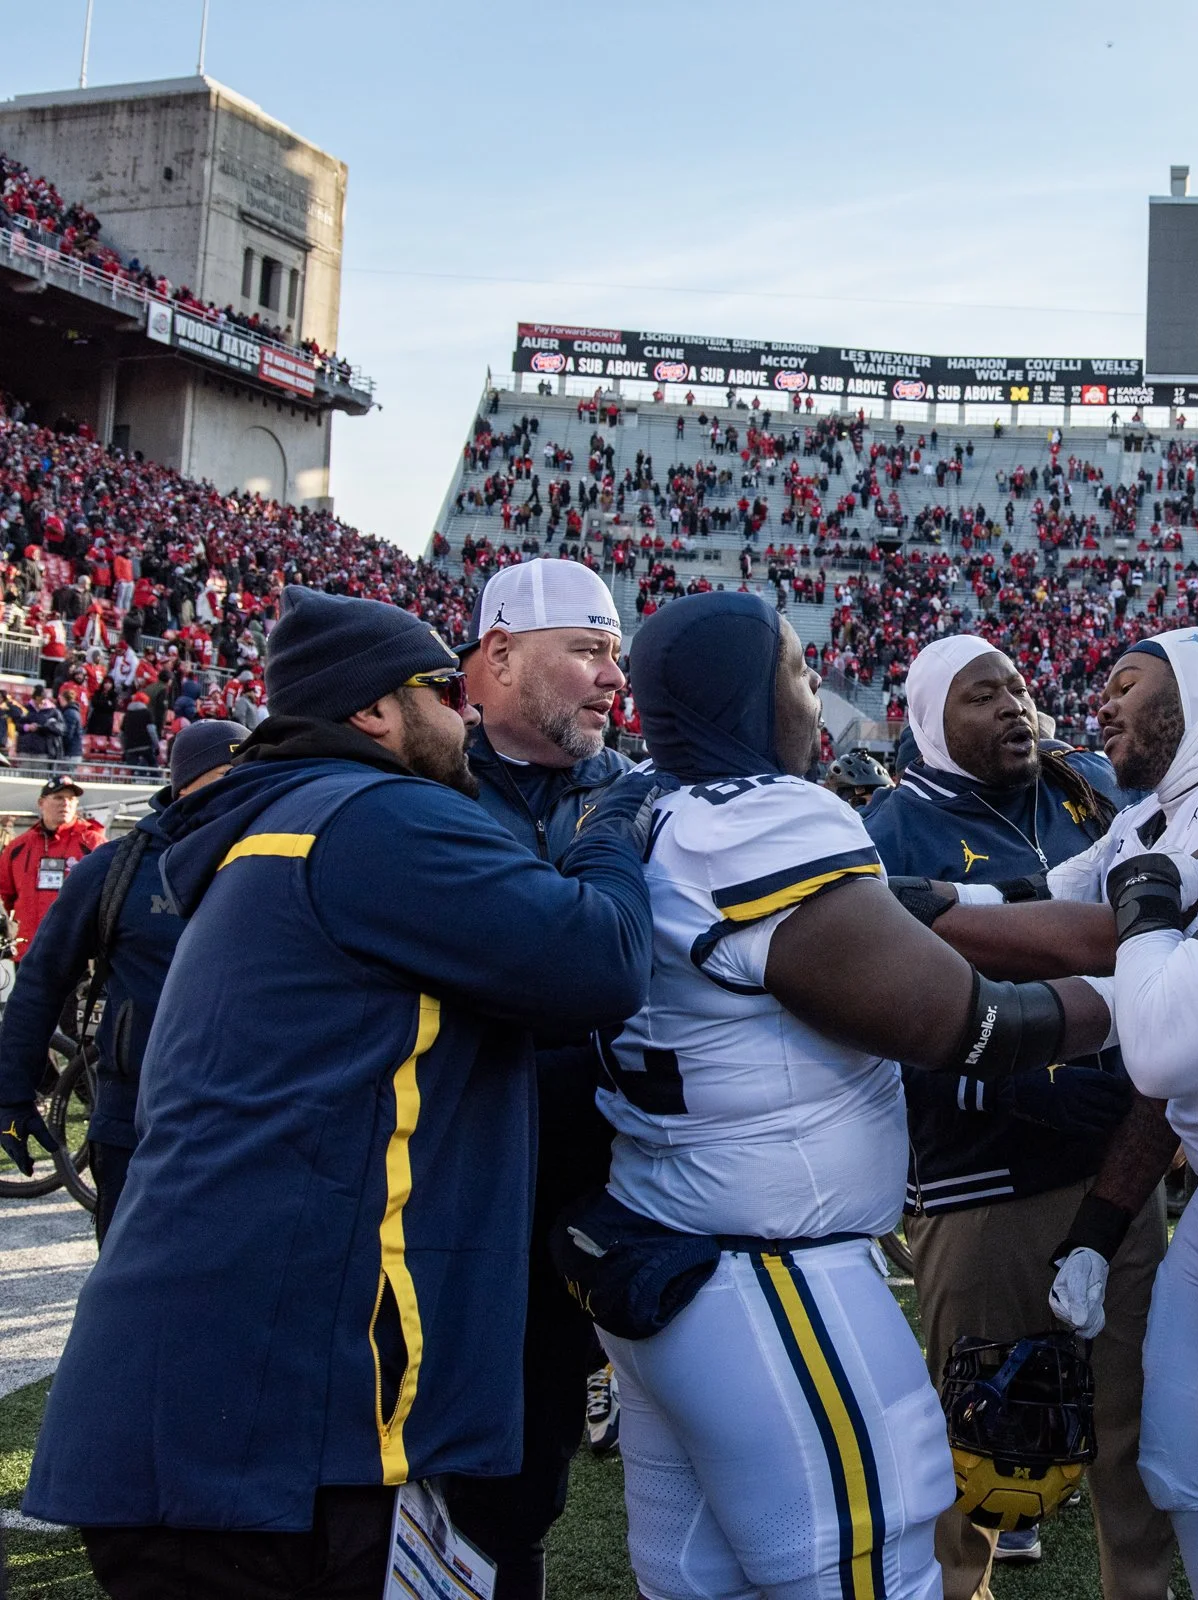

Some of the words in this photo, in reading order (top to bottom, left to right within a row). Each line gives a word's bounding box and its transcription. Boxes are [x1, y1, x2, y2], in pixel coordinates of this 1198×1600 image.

[175, 314, 221, 349] WOODY
[221, 332, 261, 365] HAYES
[551, 326, 586, 337] Forward
[587, 328, 619, 340] Society
[522, 336, 559, 350] AUER
[573, 341, 627, 356] CRONIN
[771, 341, 819, 354] DIAMOND
[643, 346, 684, 359] CLINE
[840, 349, 866, 362] LES
[869, 351, 931, 368] WEXNER
[565, 357, 575, 372] A
[578, 357, 604, 375] SUB
[760, 354, 807, 369] McCOY
[947, 358, 1007, 370] HARMON
[1025, 359, 1082, 371] COVELLI
[1091, 360, 1139, 372] WELLS
[688, 366, 697, 382] A
[700, 367, 725, 384] SUB
[853, 362, 921, 378] WANDELL
[975, 370, 1024, 381] WOLFE
[1028, 370, 1056, 382] FDN
[807, 375, 817, 390] A
[820, 376, 844, 392] SUB
[925, 384, 934, 399] A
[937, 385, 961, 400] SUB
[1010, 386, 1029, 402] M
[1117, 387, 1154, 397] KANSAS
[1174, 387, 1186, 396] 17
[1116, 395, 1153, 404] BAYLOR
